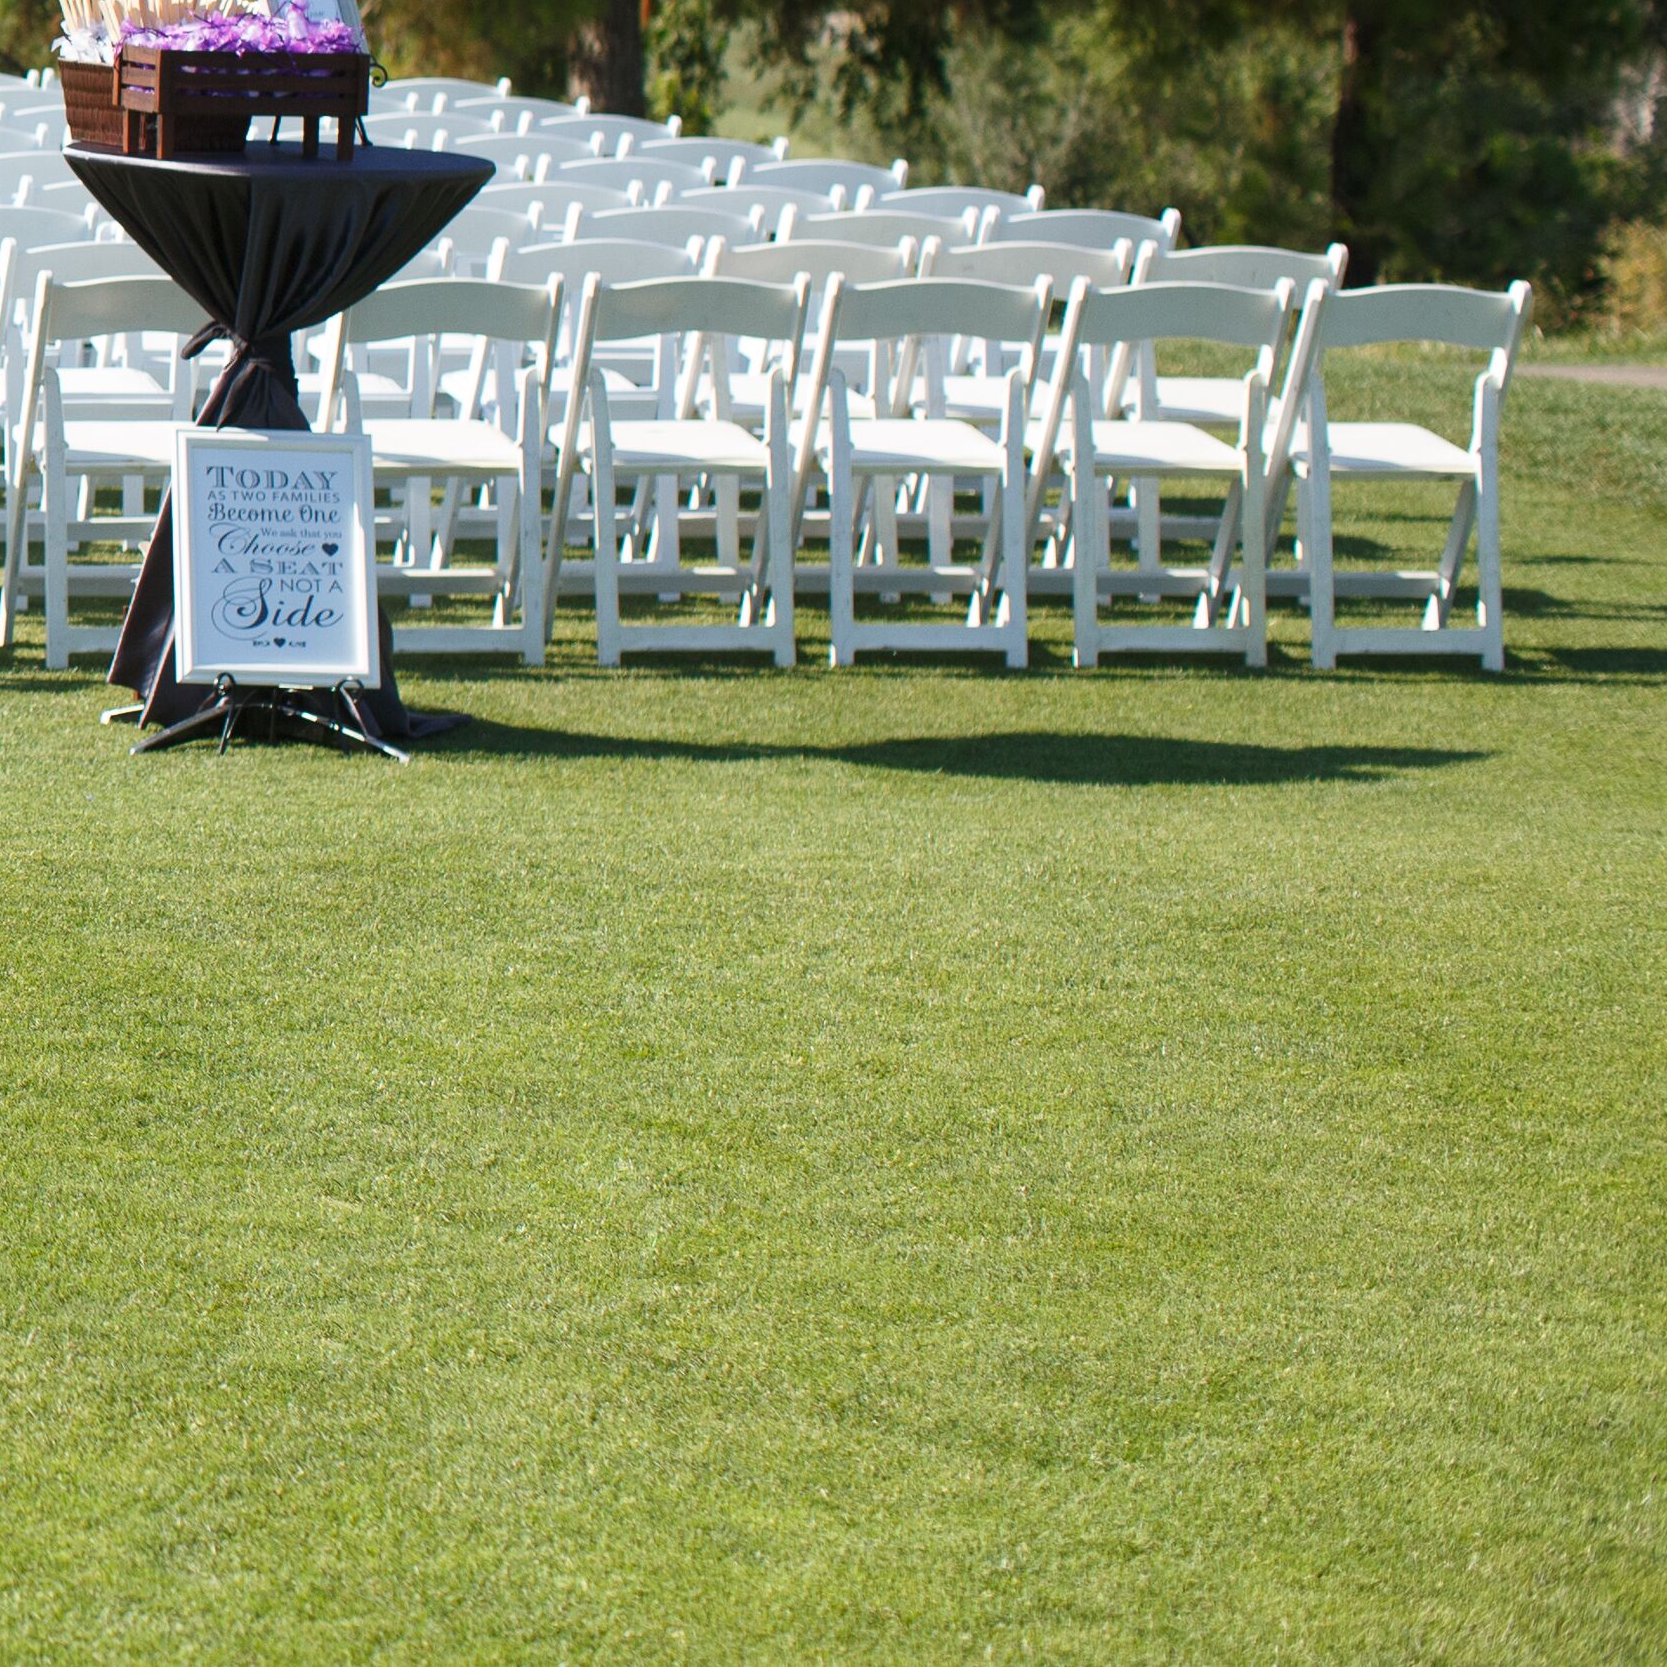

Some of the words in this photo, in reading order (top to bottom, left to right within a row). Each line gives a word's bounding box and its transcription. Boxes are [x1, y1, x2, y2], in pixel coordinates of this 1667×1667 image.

[206, 465, 338, 490] TODAY
[207, 490, 226, 501] AS
[231, 491, 266, 502] TWO
[272, 492, 340, 503] FAMILIES
[207, 502, 295, 523] Become
[299, 504, 341, 524] One
[209, 522, 316, 556] Choose
[261, 527, 277, 538] We
[279, 528, 296, 538] ask
[300, 528, 321, 539] that
[323, 529, 343, 540] you
[211, 557, 237, 574] A
[249, 558, 344, 575] SEAT
[280, 578, 321, 593] NOT
[328, 579, 344, 593] A
[211, 576, 344, 641] Side
